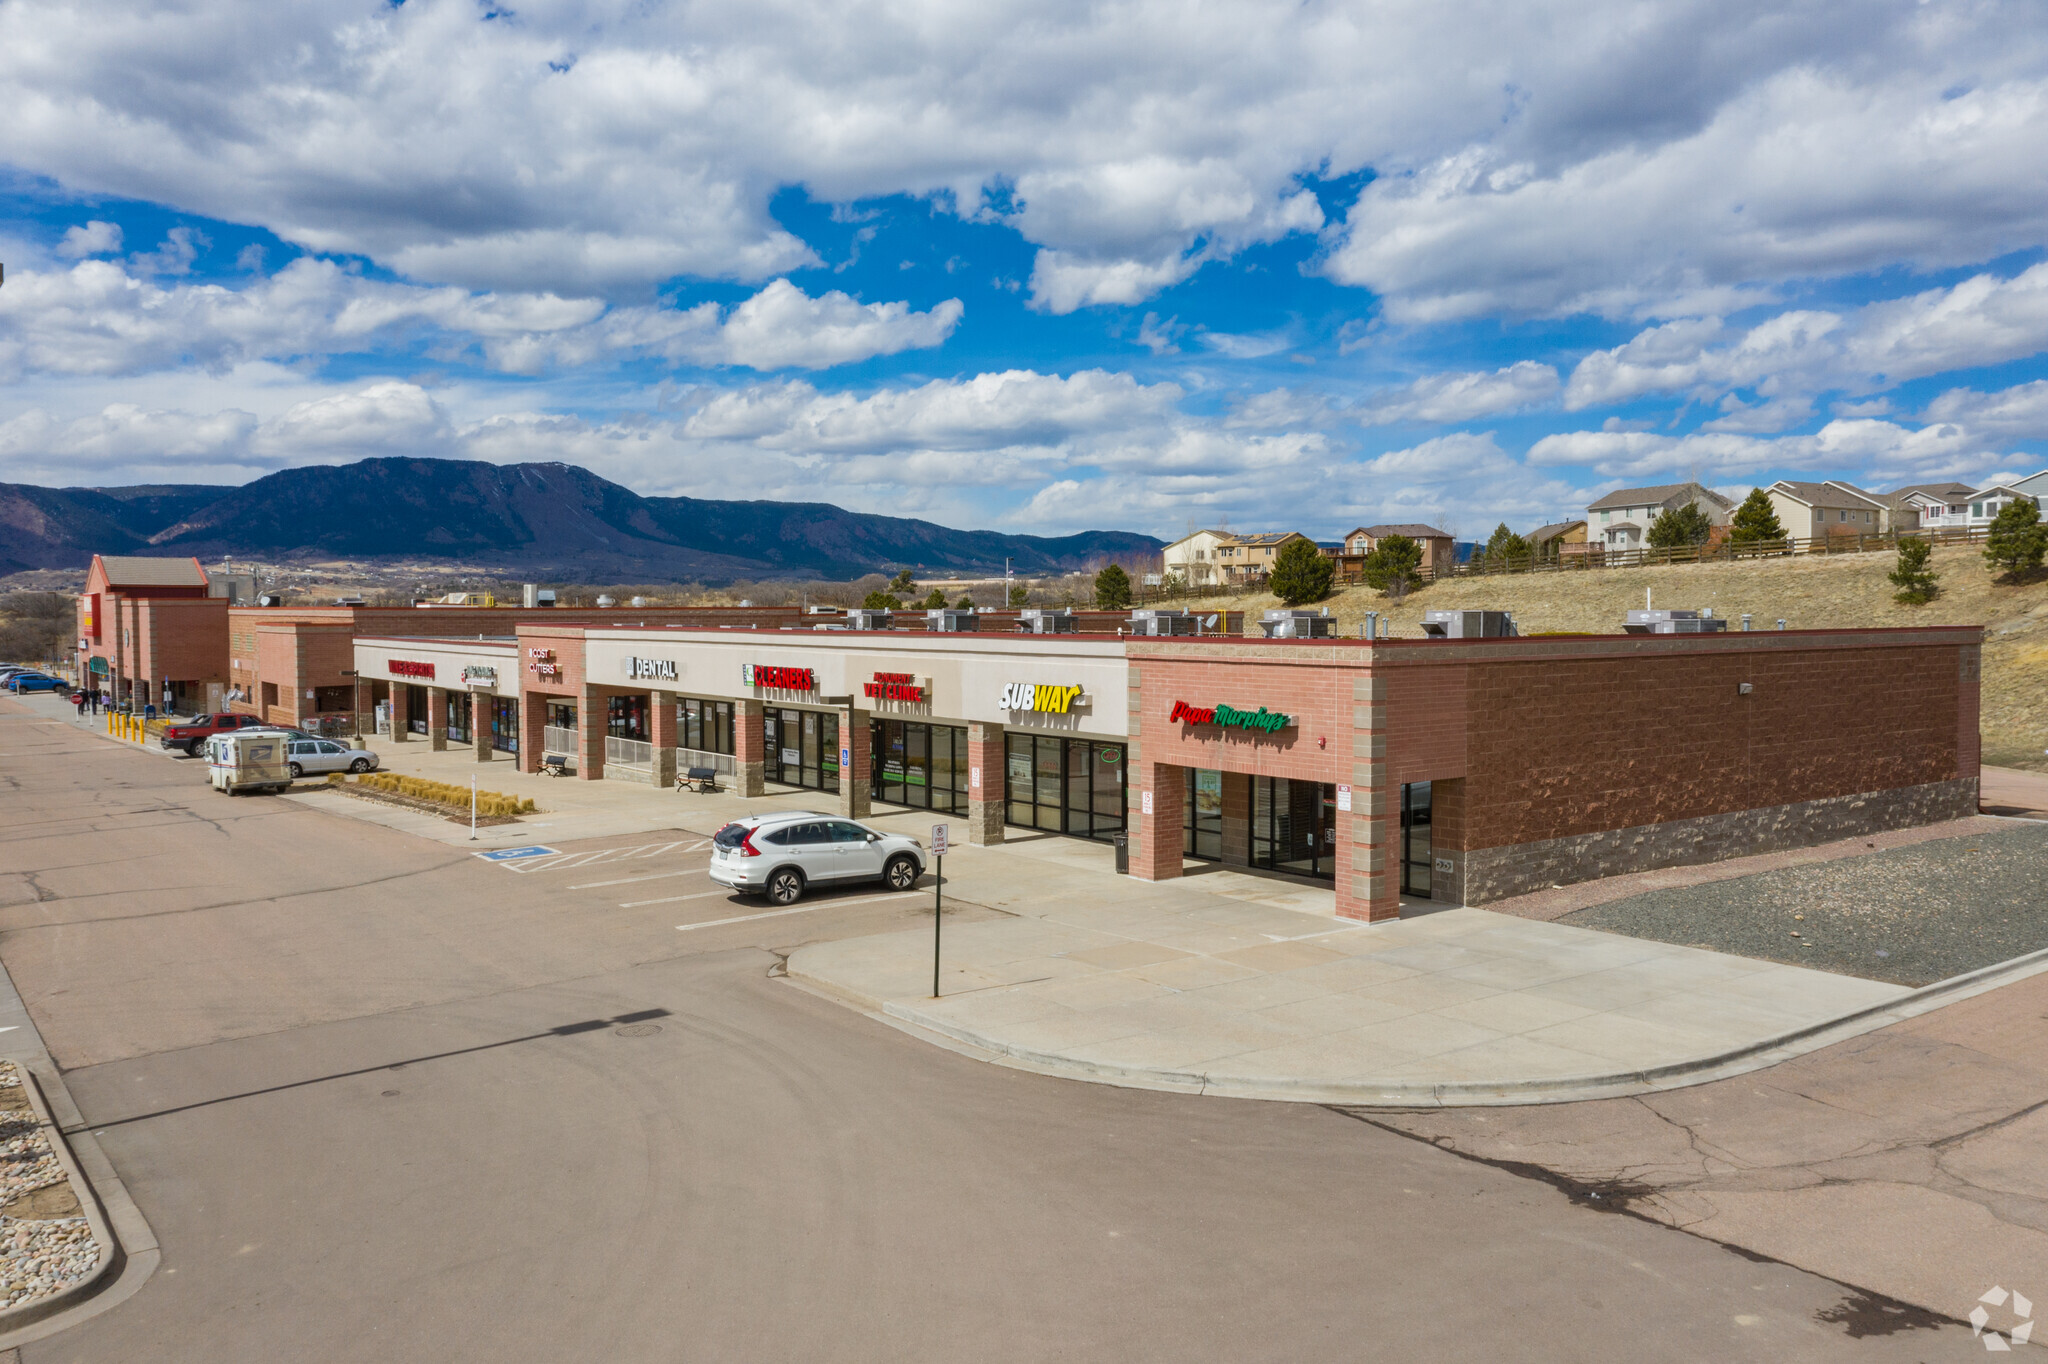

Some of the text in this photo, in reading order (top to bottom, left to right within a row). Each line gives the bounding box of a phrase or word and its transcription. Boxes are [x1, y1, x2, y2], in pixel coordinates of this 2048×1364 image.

[532, 648, 549, 659] COST
[529, 663, 555, 675] CUTTERS
[636, 659, 676, 678] DENTAL
[755, 665, 811, 691] CLEANERS
[873, 672, 912, 684] MONUMENT
[863, 682, 922, 703] VET CLINIC
[998, 683, 1080, 713] SUBWAY
[1169, 700, 1214, 726] Papa
